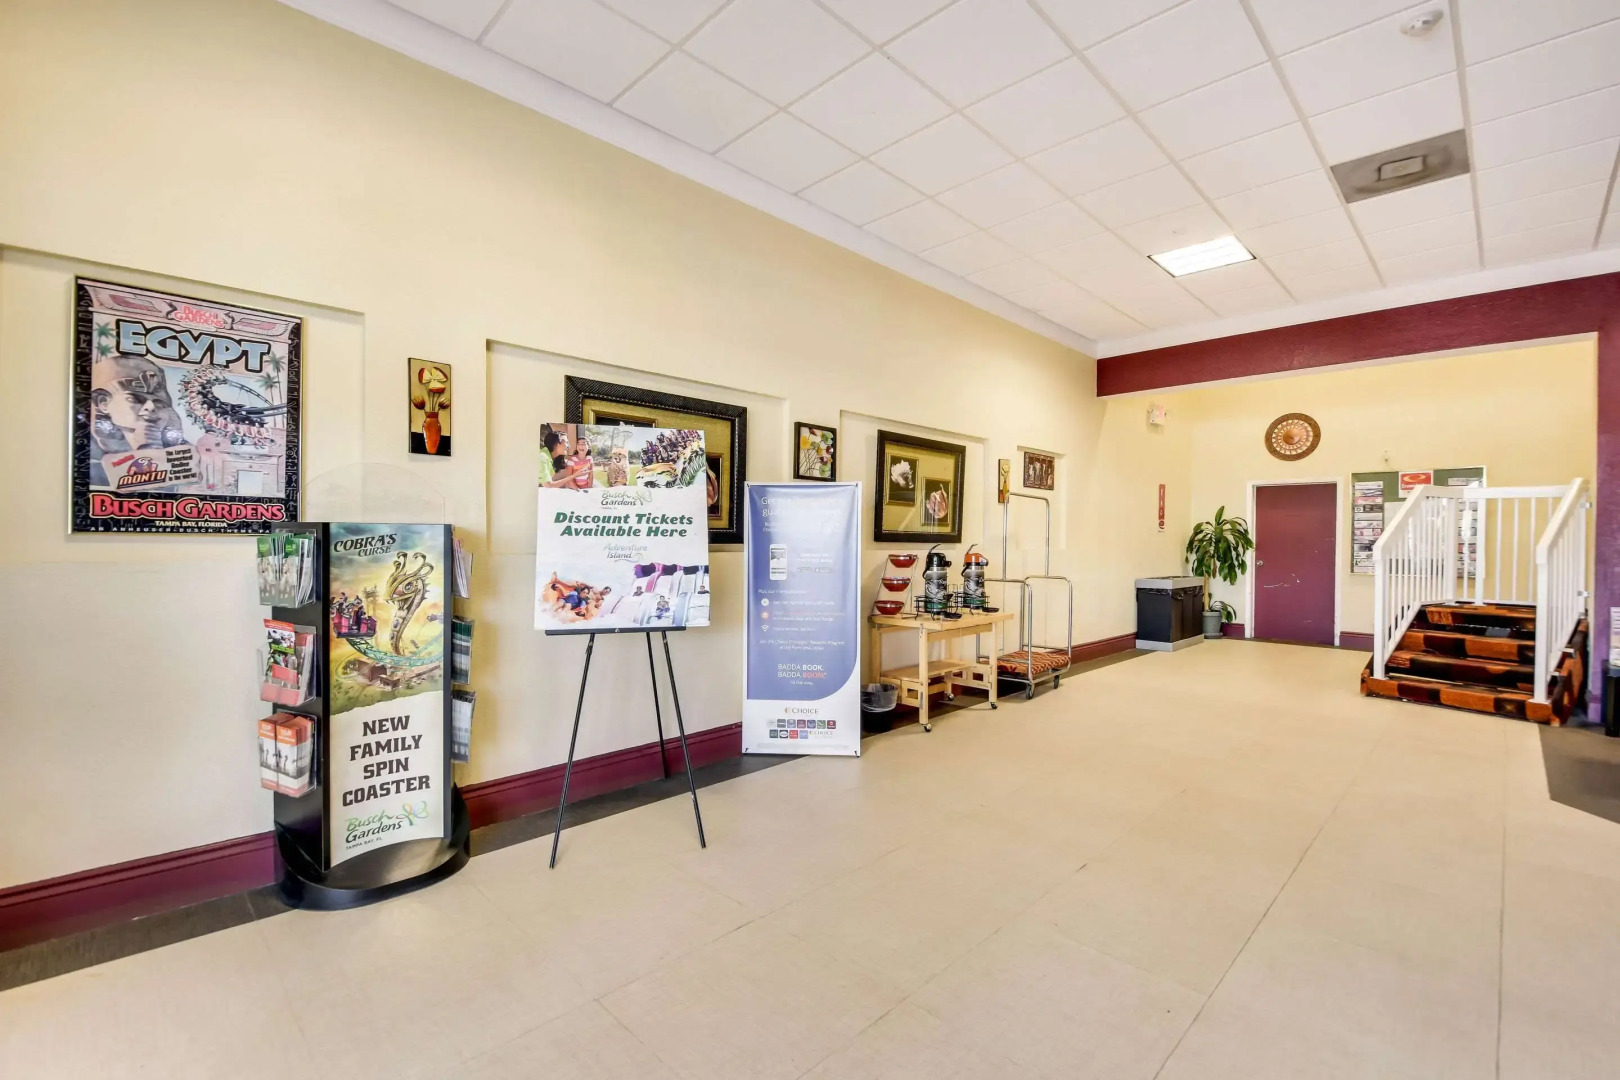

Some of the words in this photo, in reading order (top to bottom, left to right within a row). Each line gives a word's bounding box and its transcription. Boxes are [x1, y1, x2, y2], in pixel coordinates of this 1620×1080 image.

[174, 311, 224, 329] GARDENS
[116, 319, 271, 372] EGYPT
[119, 471, 167, 485] MONTU
[91, 493, 175, 519] BUSCH
[176, 497, 285, 522] GARDENS
[601, 498, 637, 507] Gardens
[554, 511, 630, 524] Discount
[635, 512, 694, 525] Tickets
[560, 524, 642, 537] Available
[645, 526, 688, 537] Here
[333, 533, 397, 552] COBRA'S
[358, 545, 392, 558] CURSE
[604, 543, 648, 551] Adventure
[362, 715, 410, 737] NEW
[349, 734, 423, 761] FAMILY
[363, 757, 410, 780] SPIN
[342, 775, 431, 807] COASTER
[346, 809, 394, 832] Busch
[345, 820, 403, 844] Gardens
